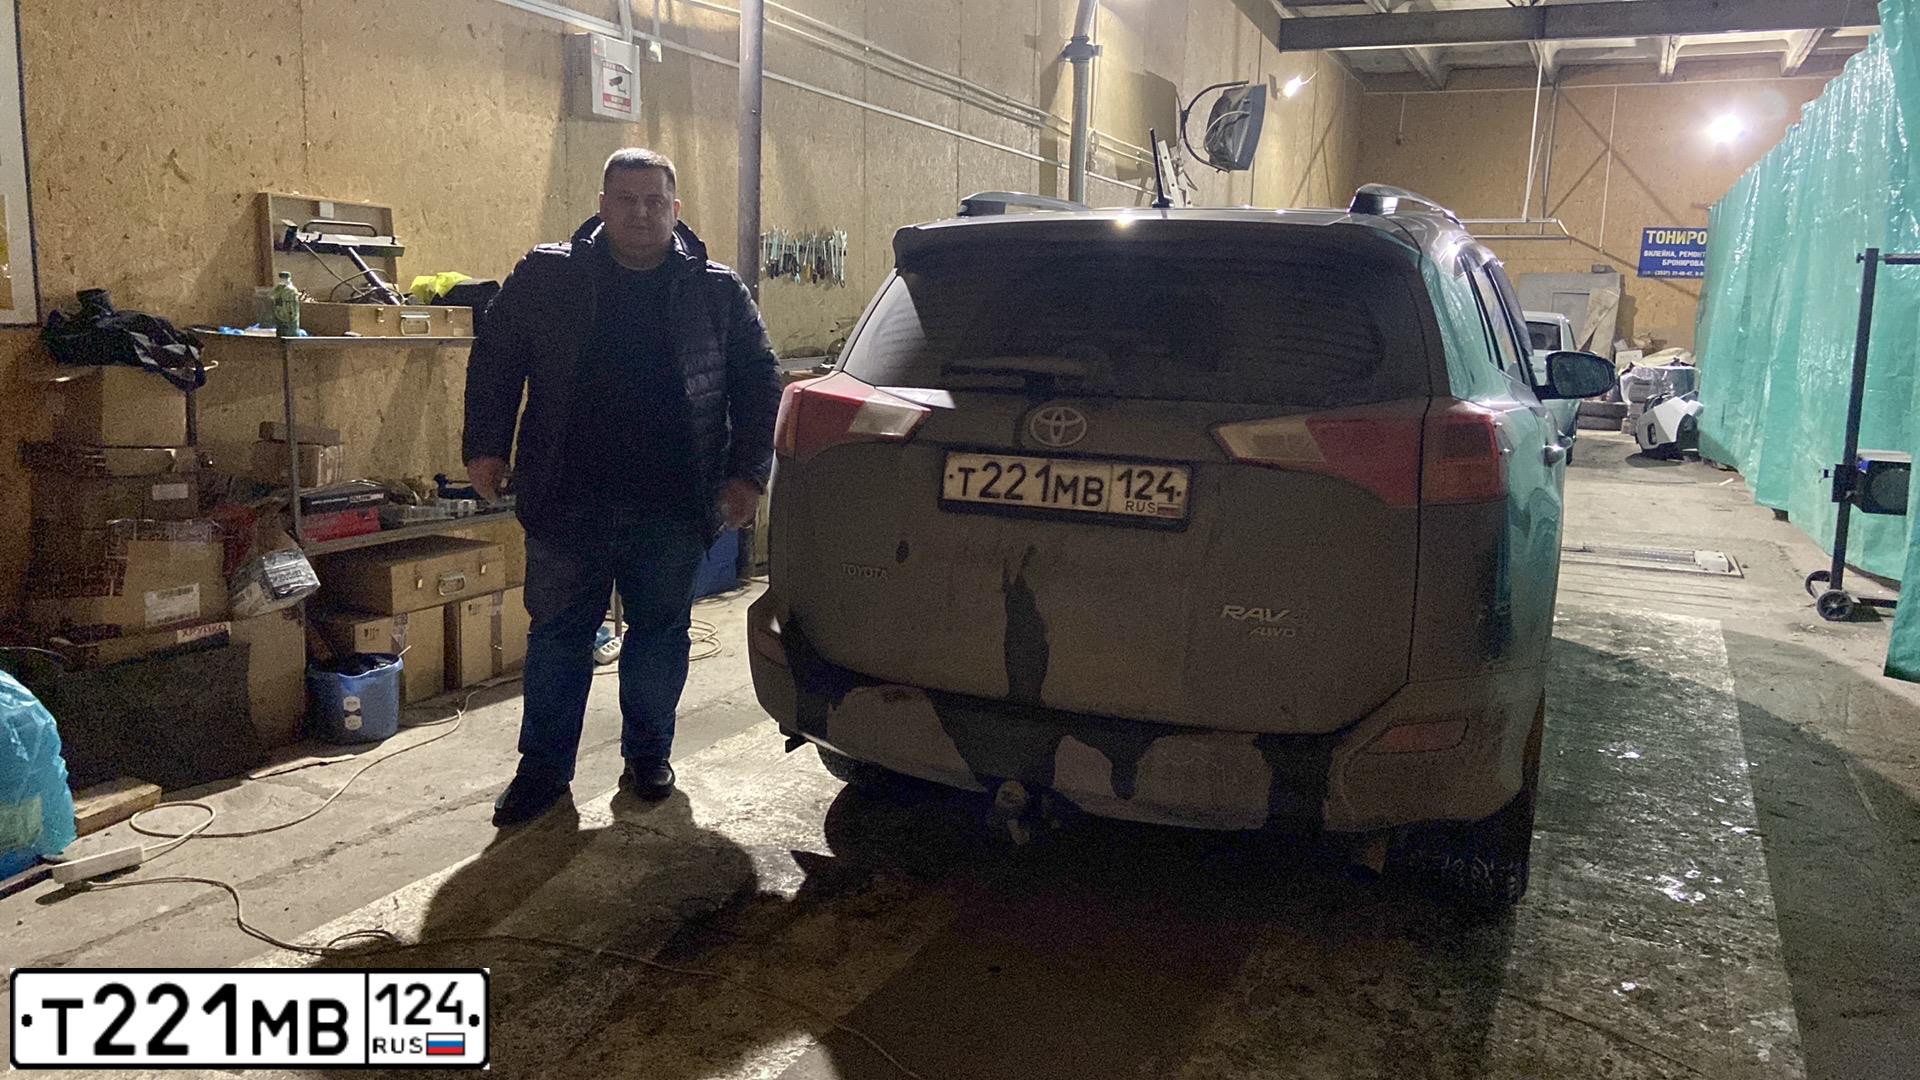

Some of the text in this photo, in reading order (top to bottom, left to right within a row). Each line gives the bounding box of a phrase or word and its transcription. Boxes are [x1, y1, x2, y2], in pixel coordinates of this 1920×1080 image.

[1646, 230, 1708, 245] ТОНИРО
[957, 461, 1176, 507] Т221МВ 124
[1125, 500, 1157, 514] RUS
[841, 563, 888, 579] TOYOTA
